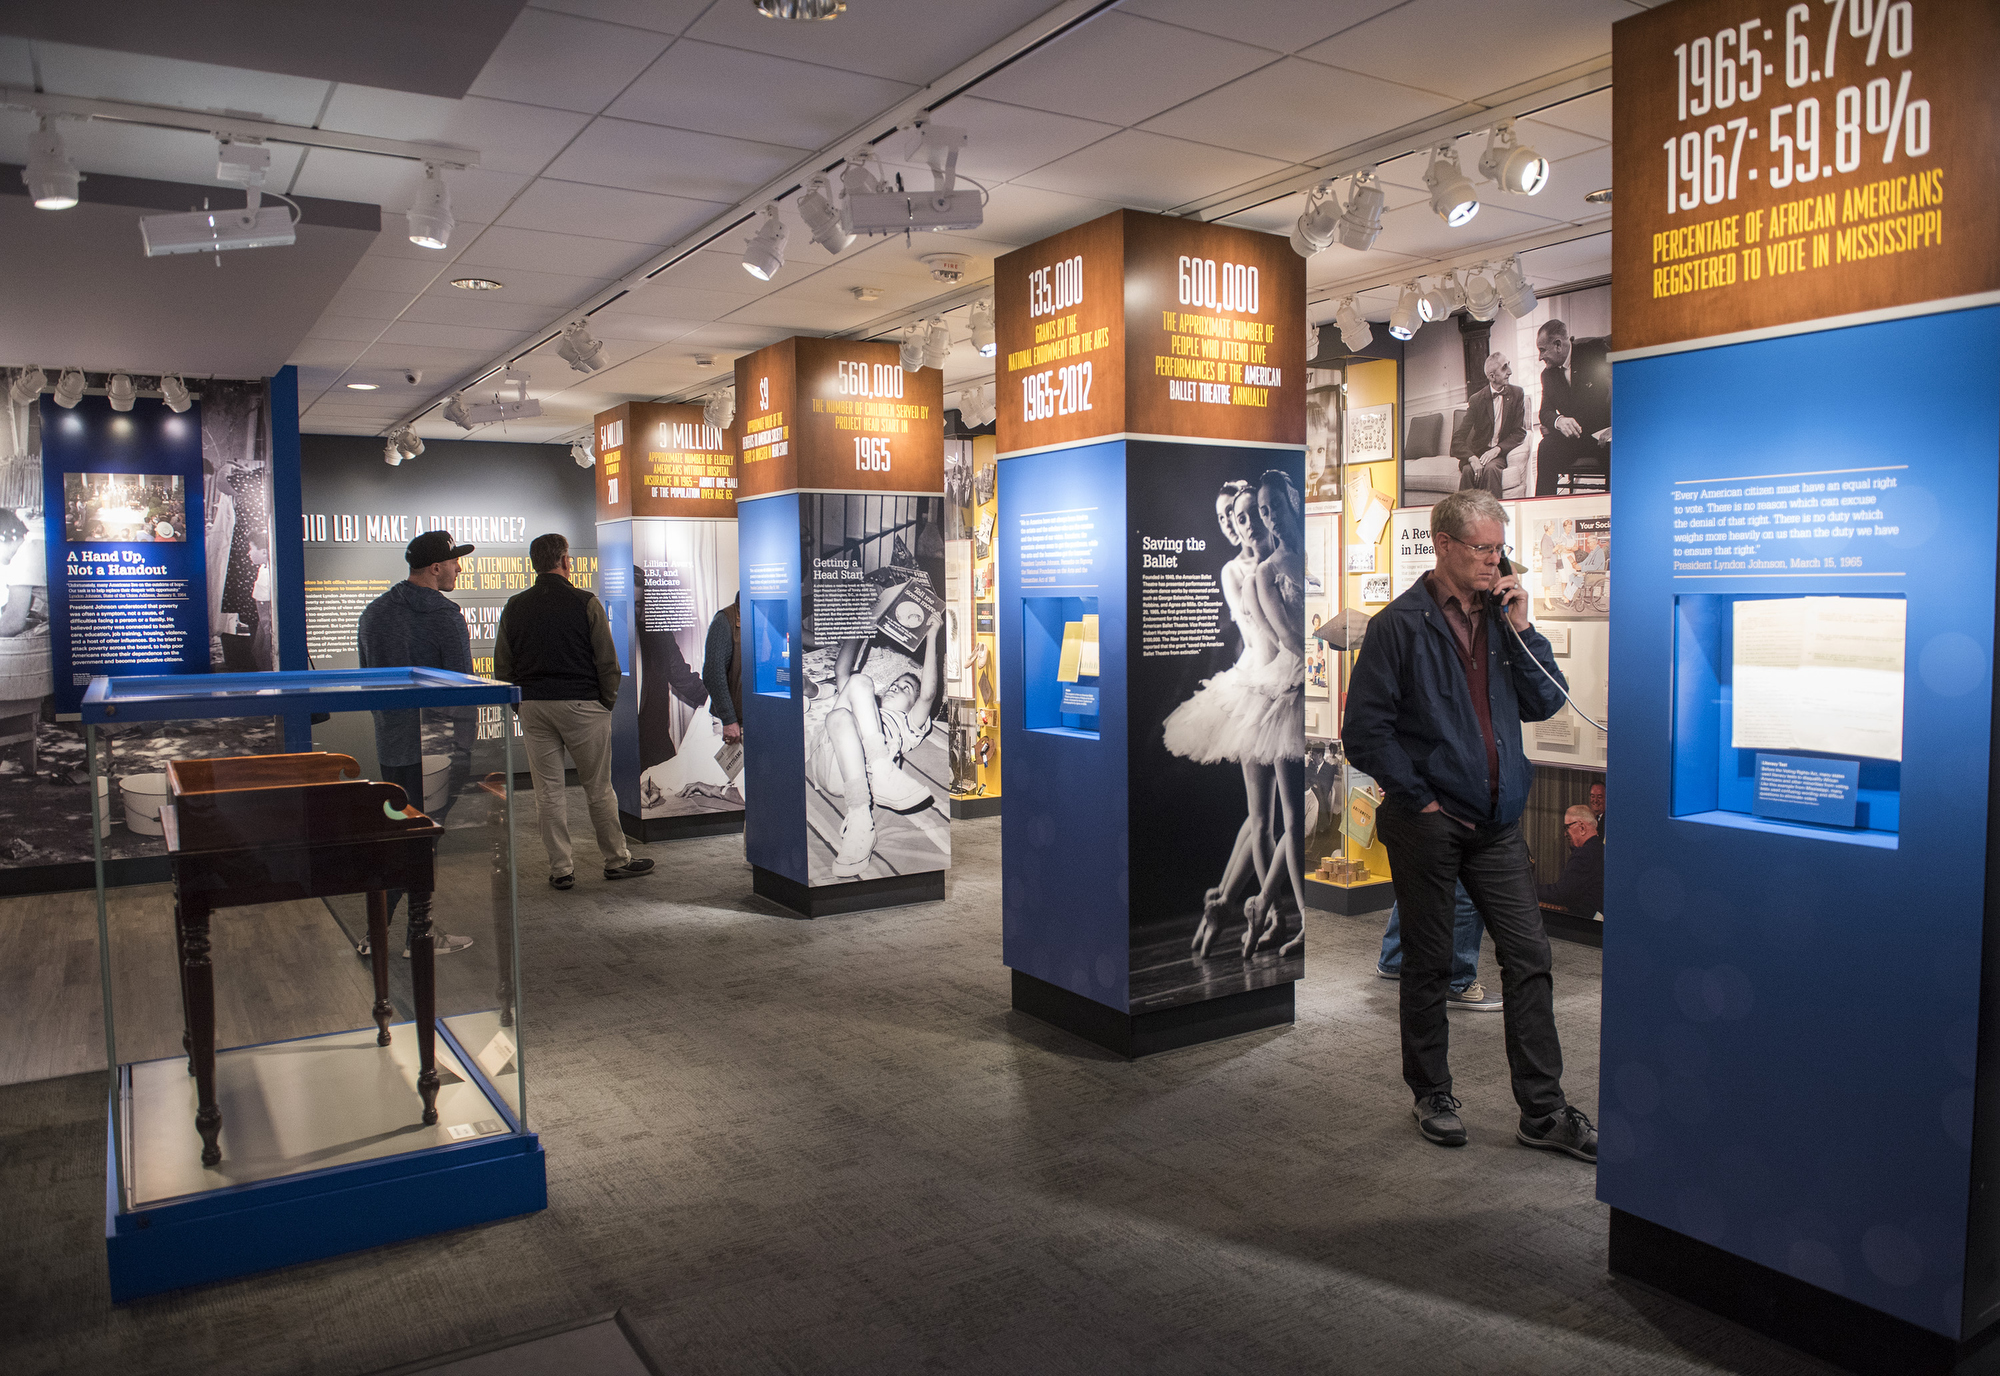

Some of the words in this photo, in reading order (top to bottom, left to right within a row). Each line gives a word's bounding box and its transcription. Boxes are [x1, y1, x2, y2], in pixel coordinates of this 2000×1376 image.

[1674, 18, 1773, 121] 1965:
[1786, 0, 1912, 89] 6.7%
[1664, 117, 1758, 214] 1967:
[1770, 70, 1930, 189] 59.8%
[1653, 215, 1739, 264] PERCENTAGE
[1745, 209, 1764, 244] OF
[1769, 193, 1836, 239] AFRICAN
[1842, 168, 1943, 223] AMERICANS
[1653, 253, 1736, 299] REGISTERED
[1742, 248, 1761, 281] TO
[1767, 238, 1806, 277] VOTE
[1813, 233, 1829, 268] IN
[1836, 209, 1942, 264] MISSISSIPPI
[1028, 255, 1082, 318] 135,000
[1179, 255, 1259, 314] 600,000
[1035, 320, 1056, 344] GRANTS
[1057, 317, 1065, 338] BY
[1066, 314, 1077, 335] THE
[1162, 310, 1176, 331] THE
[1179, 313, 1231, 339] APPROXIMATE
[1233, 320, 1263, 342] NUMBER
[1265, 324, 1275, 343] OF
[1008, 348, 1032, 372] NATIONAL
[1033, 338, 1068, 366] ENDOWMENT
[1069, 334, 1081, 357] FOR
[1081, 331, 1093, 354] THE
[1093, 326, 1109, 350] ARTS
[1171, 335, 1199, 357] PEOPLE
[1201, 338, 1219, 359] WHO
[1221, 341, 1249, 362] ATTEND
[1250, 344, 1267, 364] LIVE
[838, 360, 903, 399] 560,000
[1155, 355, 1215, 381] PERFORMANCES
[1217, 362, 1227, 382] OF
[1229, 363, 1243, 384] THE
[1244, 365, 1281, 387] AMERICAN
[760, 377, 769, 411] $9
[1022, 361, 1092, 422] 1965-2012
[1169, 380, 1197, 402] BALLET
[1199, 382, 1231, 405] THEATRE
[1232, 386, 1269, 407] ANNUALLY
[812, 398, 824, 412] THE
[826, 400, 854, 415] NUMBER
[854, 401, 863, 415] OF
[865, 402, 895, 417] CHILDREN
[896, 404, 919, 419] SERVED
[920, 406, 929, 419] BY
[835, 415, 861, 430] PROJECT
[863, 417, 879, 432] HEAD
[881, 418, 899, 433] START
[901, 419, 908, 433] IN
[659, 422, 667, 448] 9
[673, 423, 723, 450] MILLION
[648, 452, 683, 464] APPROXIMATE
[684, 453, 705, 464] NUMBER
[706, 454, 713, 465] OF
[714, 454, 734, 465] ELDERLY
[853, 437, 891, 472] 1965
[653, 463, 682, 475] AMERICANS
[683, 465, 706, 476] WITHOUT
[706, 465, 730, 477] HOSPITAL
[644, 475, 672, 486] INSURANCE
[673, 476, 680, 487] IN
[699, 477, 715, 488] ABOUT
[1700, 488, 1742, 499] American
[1745, 486, 1774, 496] citizen
[1776, 484, 1800, 494] must
[1802, 482, 1825, 492] have
[1827, 482, 1840, 491] an
[1842, 478, 1870, 491] equal
[1873, 477, 1897, 490] right
[651, 487, 658, 497] OF
[659, 487, 669, 498] THE
[670, 487, 700, 498] POPULATION
[701, 488, 714, 499] OVER
[715, 489, 724, 500] AGE
[725, 489, 733, 500] 65
[1674, 506, 1683, 514] to
[1685, 505, 1705, 514] vote.
[1707, 502, 1732, 513] There
[1734, 502, 1742, 512] is
[1743, 502, 1755, 511] no
[1757, 500, 1787, 510] reason
[1789, 497, 1818, 508] which
[1820, 497, 1839, 506] can
[1841, 495, 1877, 506] excuse
[332, 514, 360, 542] LBJ
[366, 515, 409, 543] MAKE
[414, 515, 424, 538] A
[429, 516, 526, 543] DIFFERENCE?
[1401, 529, 1409, 540] A
[1580, 522, 1595, 530] Your
[1142, 536, 1184, 554] Saving
[1186, 537, 1206, 551] the
[1401, 544, 1411, 555] in
[1673, 548, 1682, 556] to
[1684, 546, 1713, 556] ensure
[1714, 545, 1732, 555] that
[66, 551, 78, 562] A
[81, 551, 119, 562] Hand
[121, 551, 145, 564] Up,
[477, 557, 523, 573] ATTENDING
[577, 557, 588, 573] OR
[813, 558, 850, 569] Getting
[1142, 554, 1178, 568] Ballet
[1673, 560, 1712, 570] President
[1714, 559, 1746, 571] Lyndon
[1748, 559, 1788, 570] Johnson,
[1790, 558, 1821, 568] March
[1824, 557, 1836, 568] 15,
[1840, 556, 1863, 567] 1965
[67, 564, 93, 576] Not
[96, 567, 105, 576] a
[108, 564, 167, 576] Handout
[644, 569, 661, 577] LBJ,
[813, 570, 839, 579] Head
[841, 570, 864, 580] Start
[480, 573, 528, 590] 1960-1970:
[644, 578, 680, 586] Medicare
[904, 589, 921, 604] some
[914, 586, 925, 598] Tell
[924, 595, 935, 605] me
